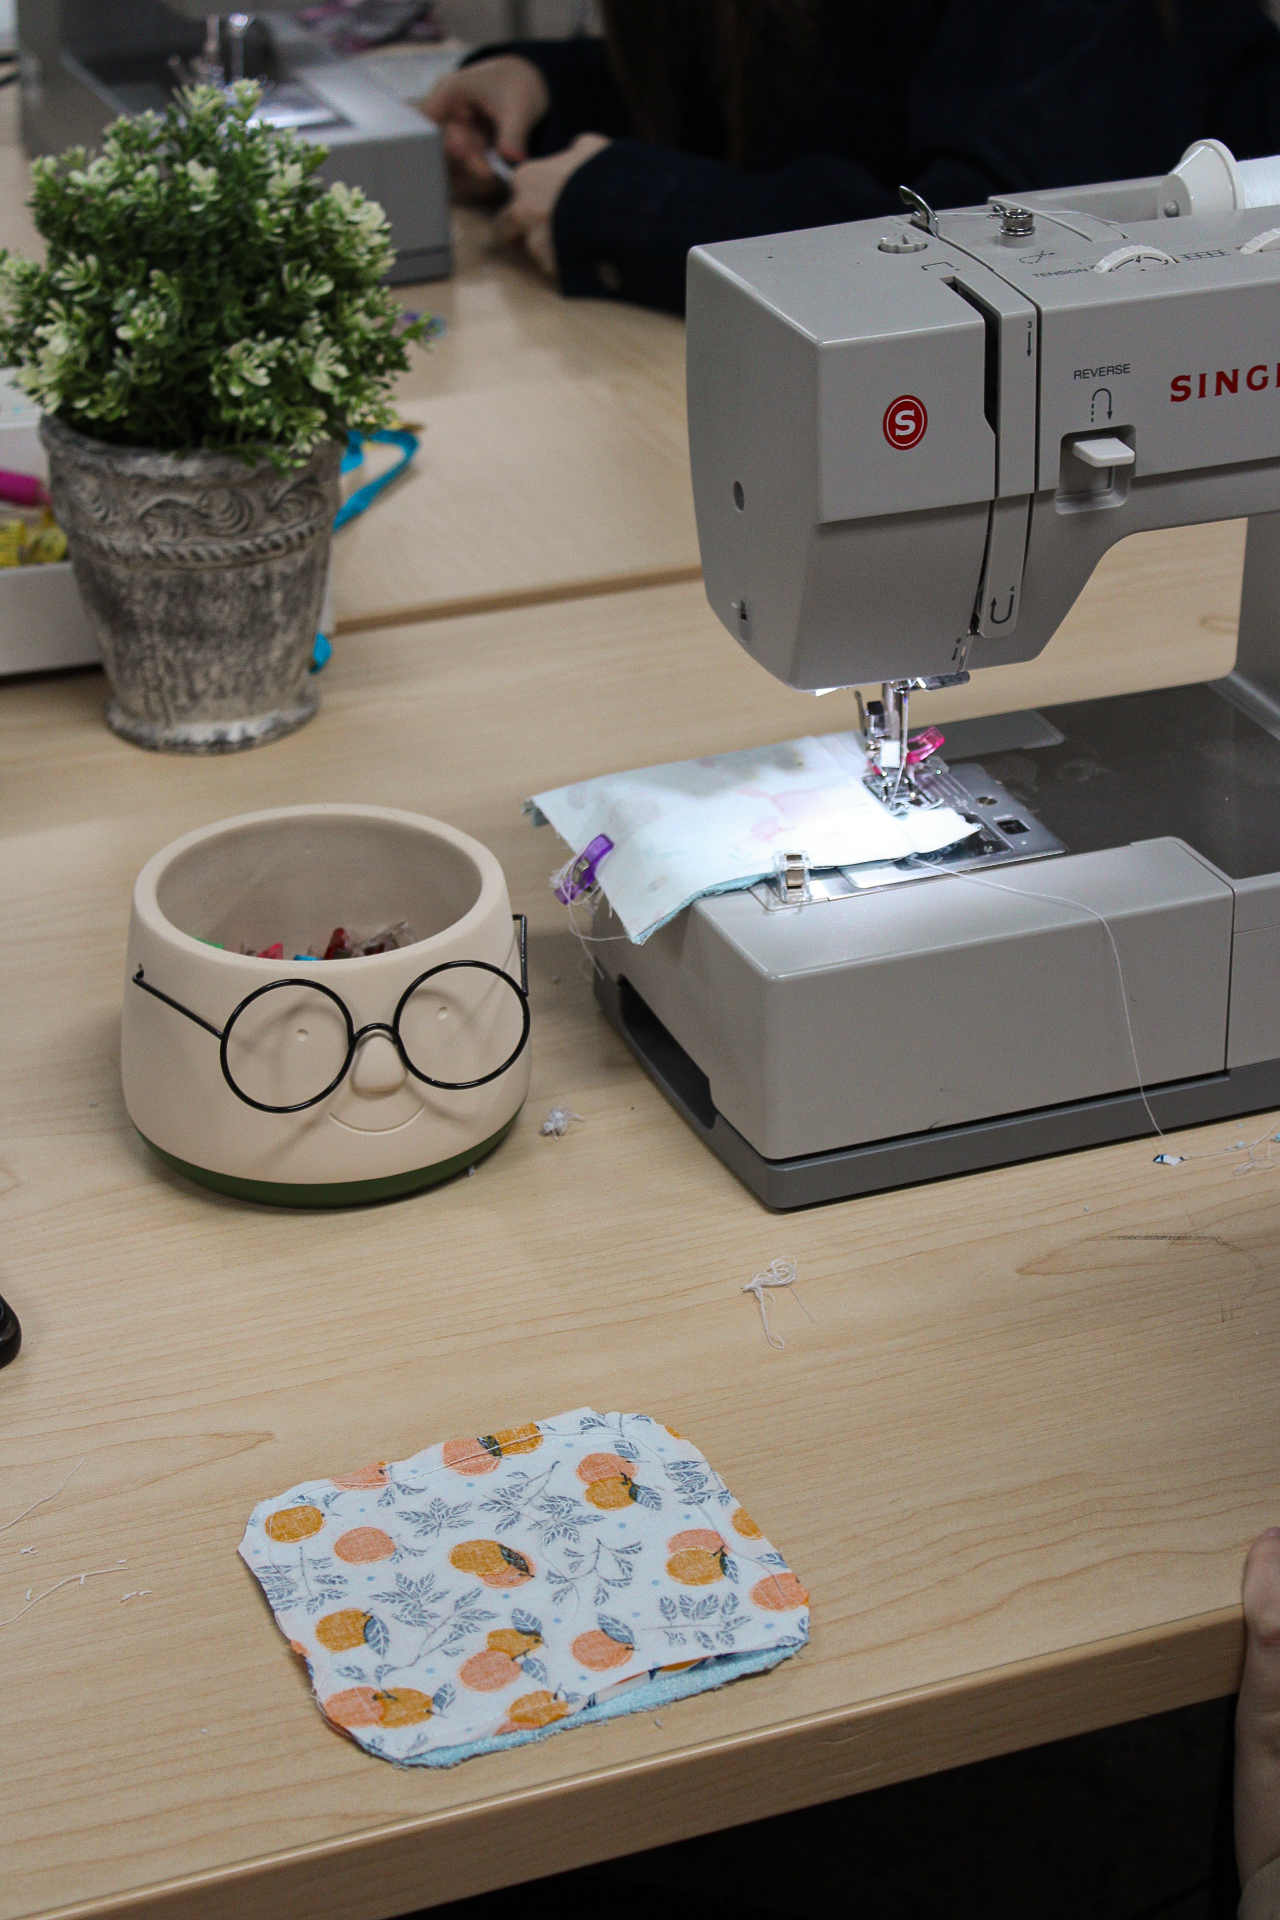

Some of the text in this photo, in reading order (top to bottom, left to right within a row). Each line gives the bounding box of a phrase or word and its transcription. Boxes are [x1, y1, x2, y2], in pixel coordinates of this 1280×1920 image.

[1031, 267, 1089, 278] TENSION
[1027, 320, 1033, 329] 3
[1073, 363, 1131, 380] REVERSE
[894, 408, 917, 437] S
